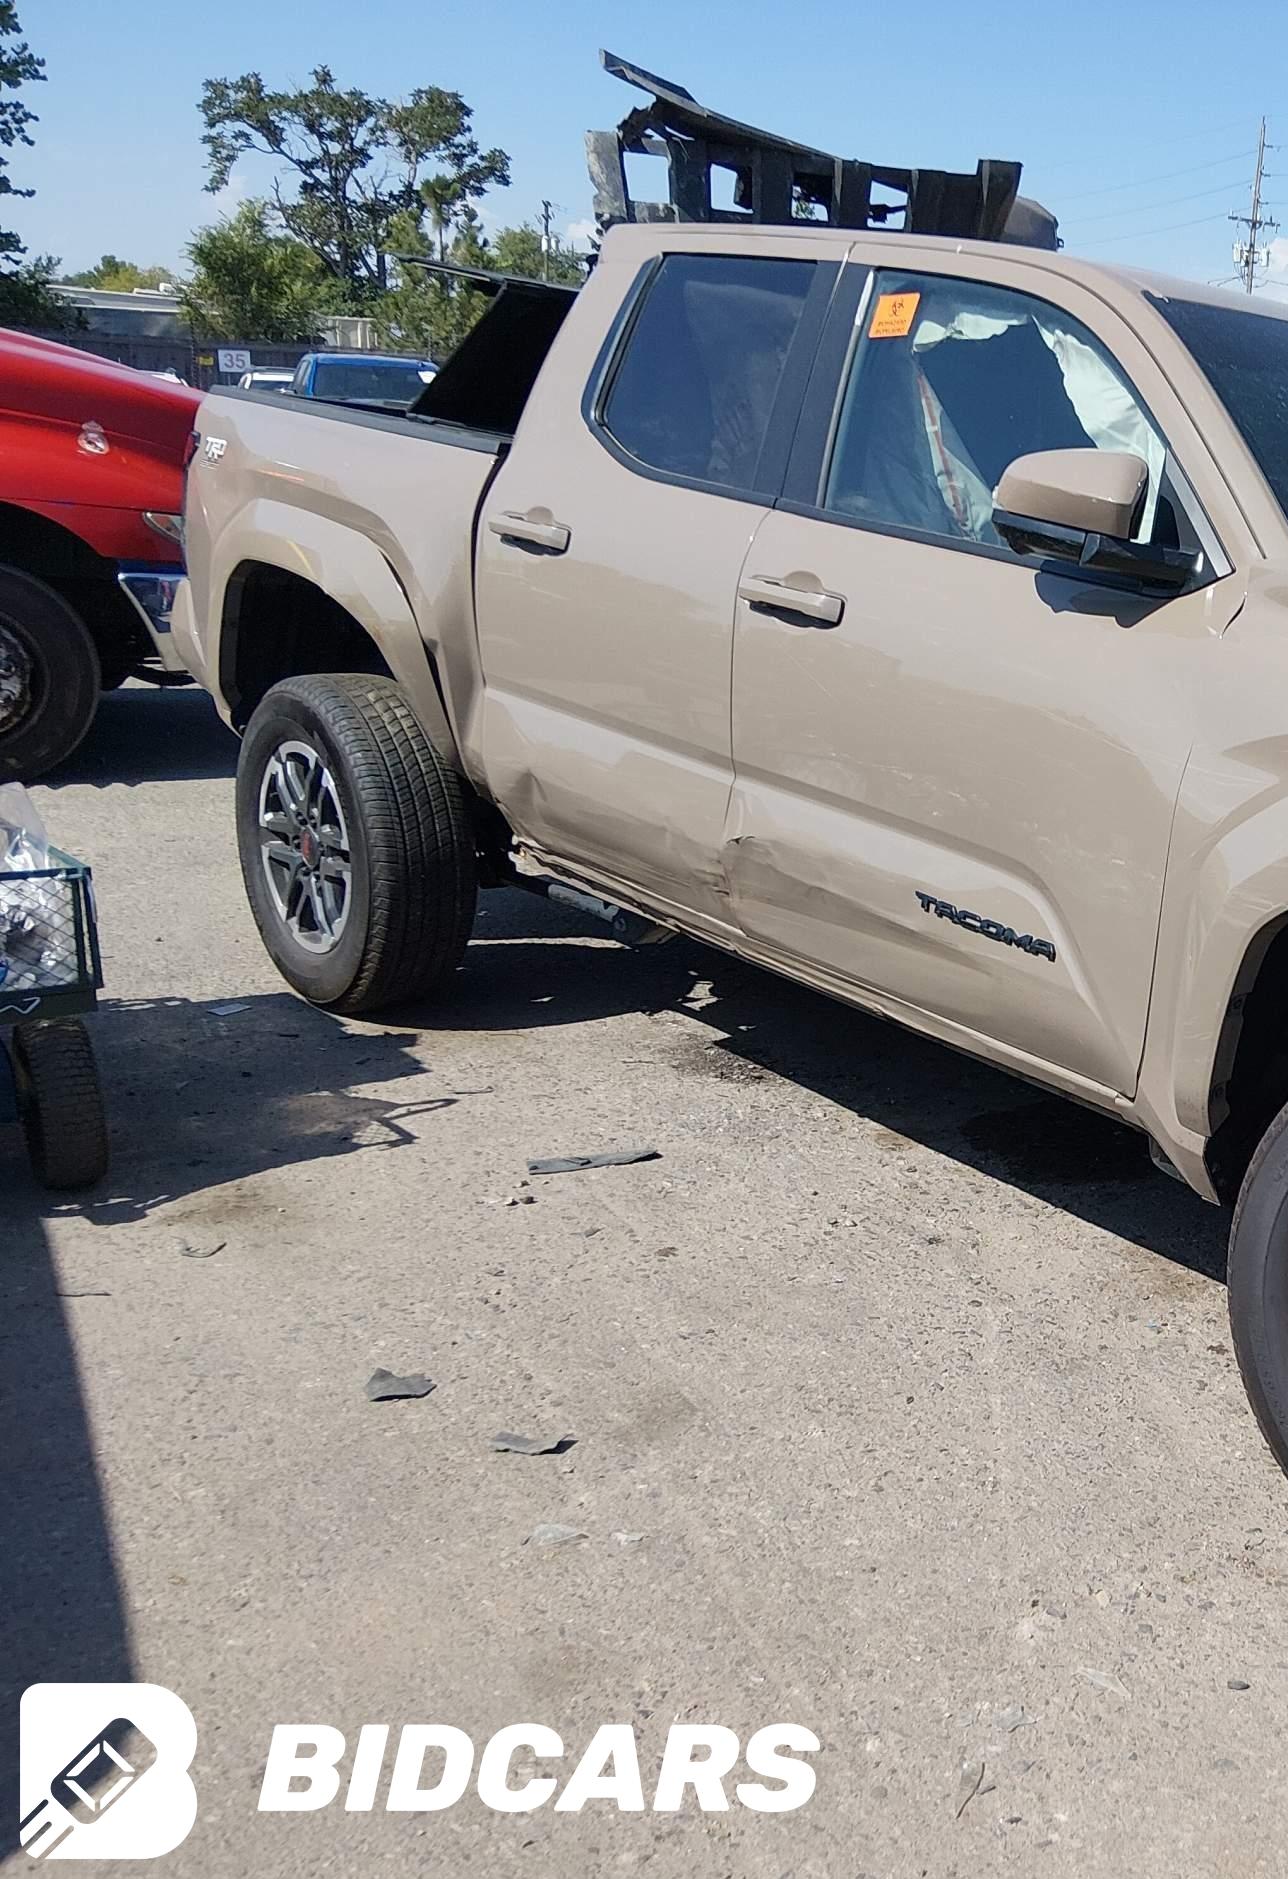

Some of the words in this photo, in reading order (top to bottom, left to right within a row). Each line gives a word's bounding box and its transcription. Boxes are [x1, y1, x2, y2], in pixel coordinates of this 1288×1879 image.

[223, 353, 246, 369] 35
[205, 436, 227, 460] TRD
[915, 890, 1056, 963] TACOMA
